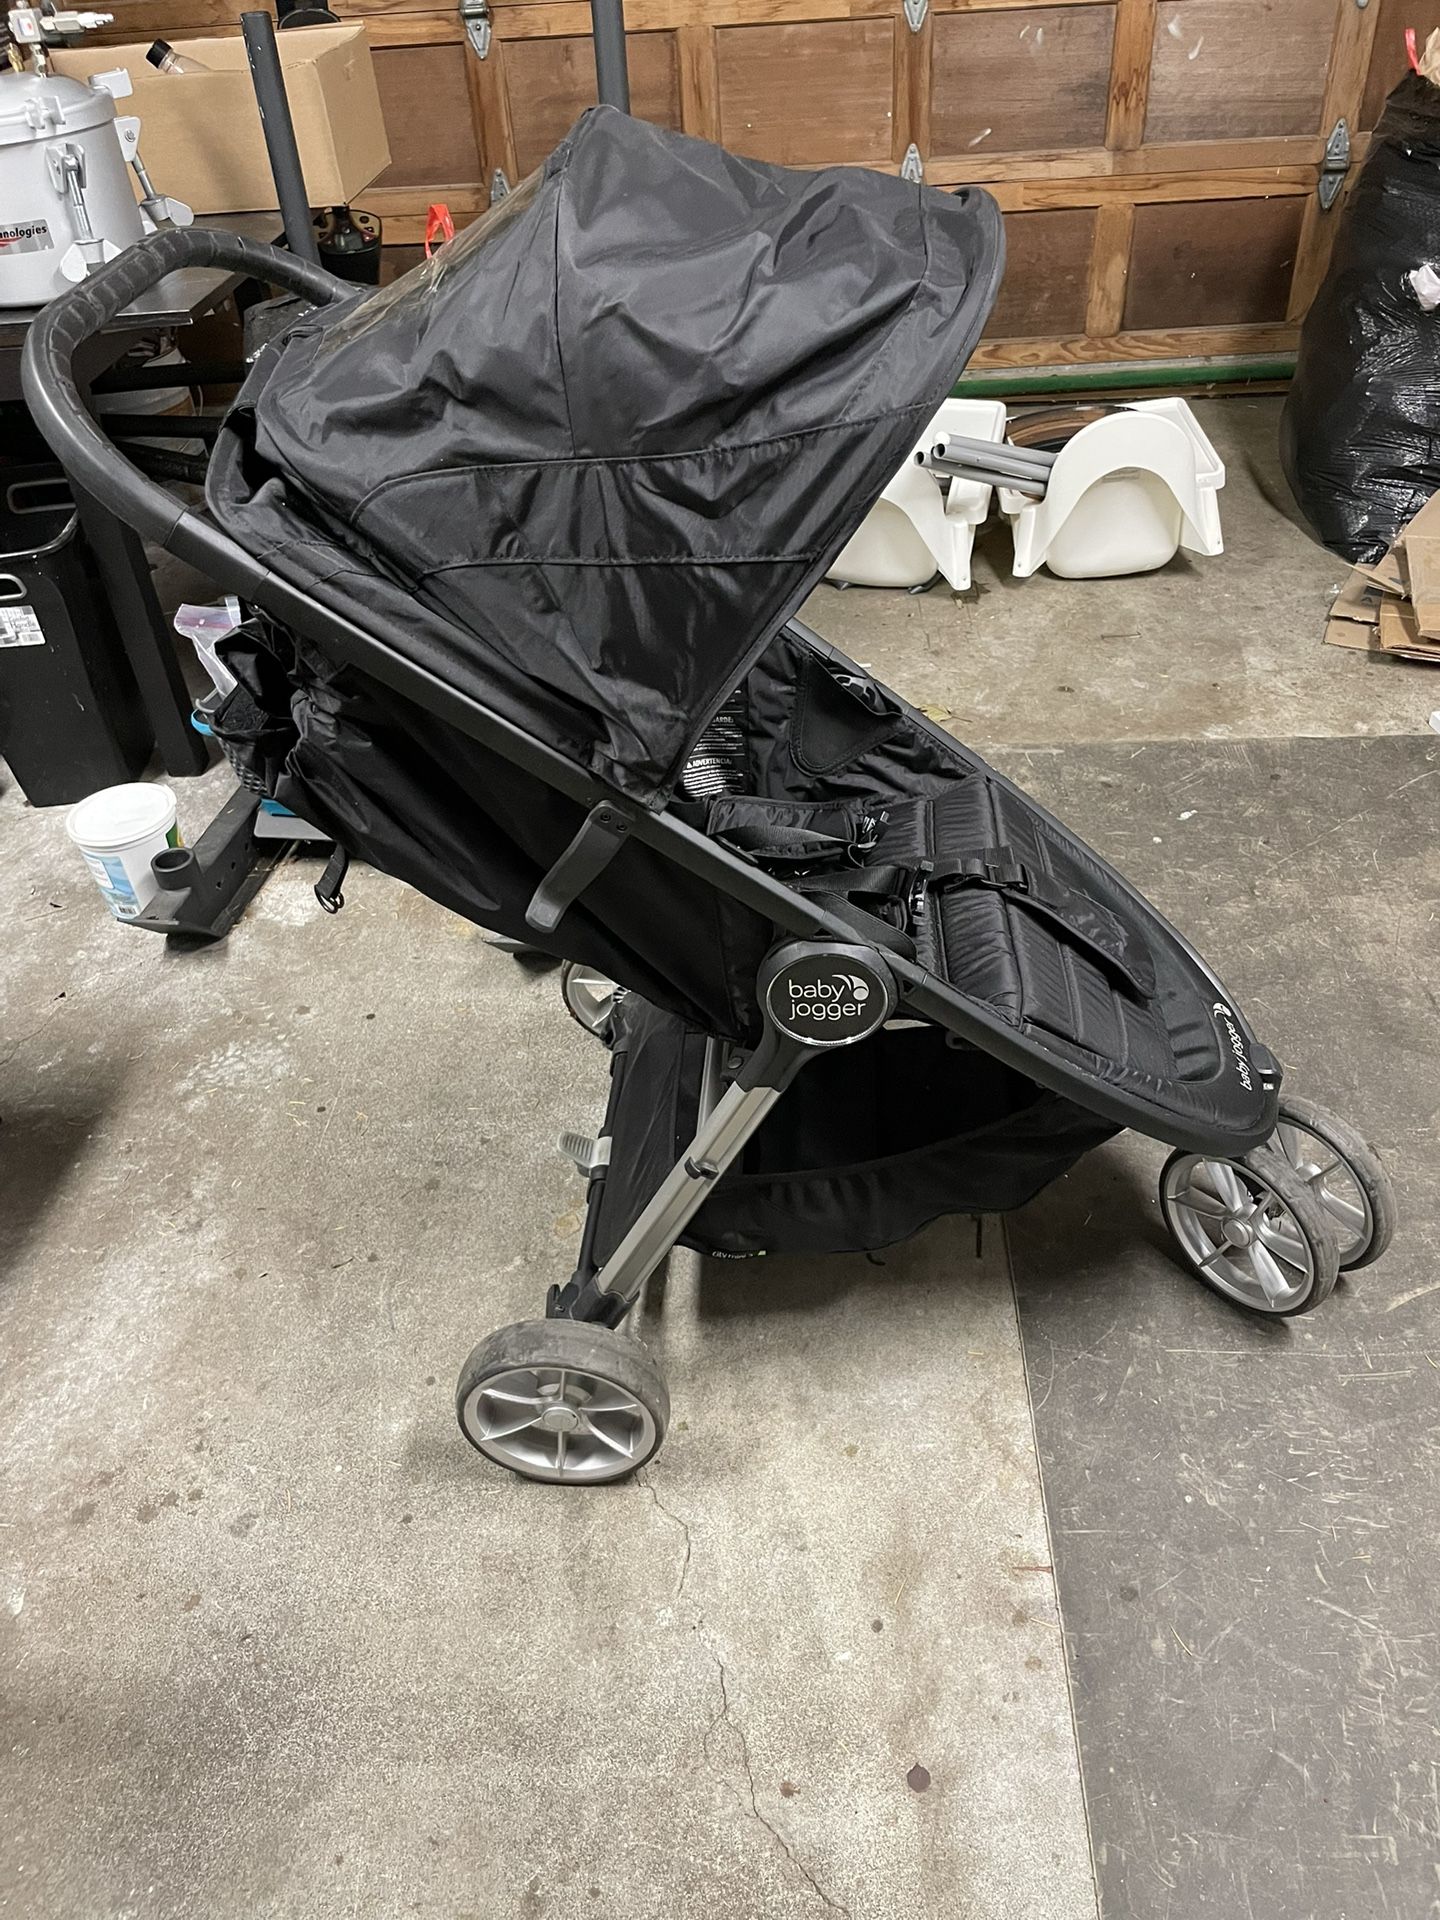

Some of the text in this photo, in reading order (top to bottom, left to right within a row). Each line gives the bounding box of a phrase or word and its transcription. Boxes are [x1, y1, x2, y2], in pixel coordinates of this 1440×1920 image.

[788, 979, 845, 1002] baby
[788, 1000, 866, 1020] jogger
[1223, 1017, 1253, 1091] baby jogger
